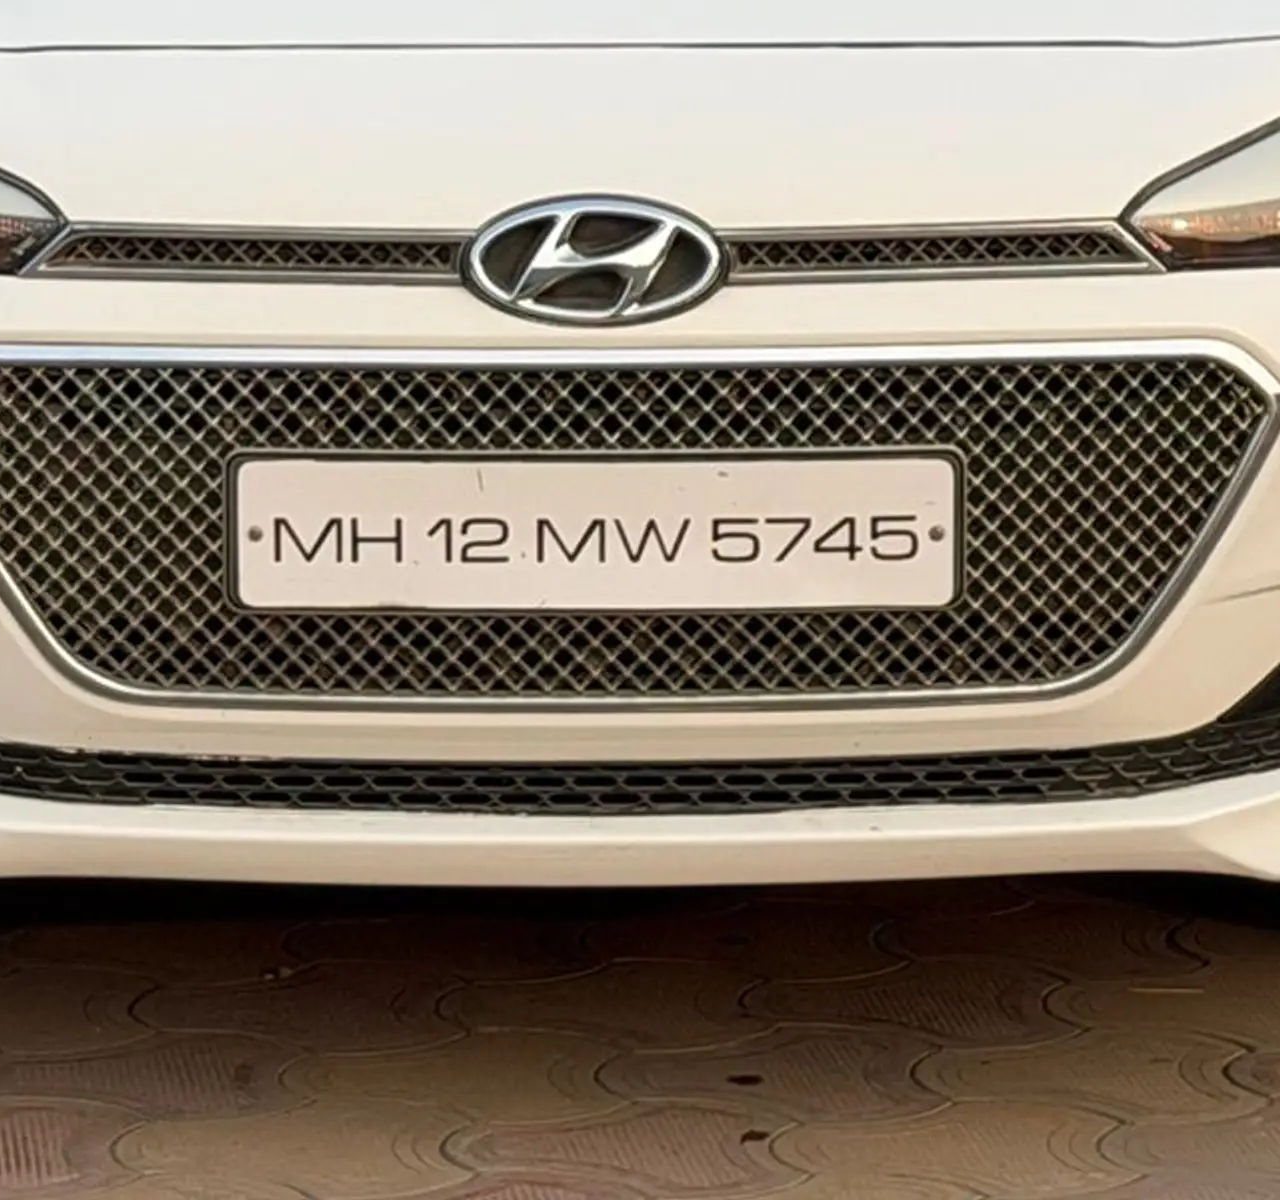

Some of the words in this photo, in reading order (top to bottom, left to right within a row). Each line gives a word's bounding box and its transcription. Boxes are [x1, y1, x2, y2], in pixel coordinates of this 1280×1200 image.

[273, 517, 403, 563] MH
[427, 517, 510, 563] 12
[536, 517, 691, 563] MW
[711, 515, 919, 563] 5745
